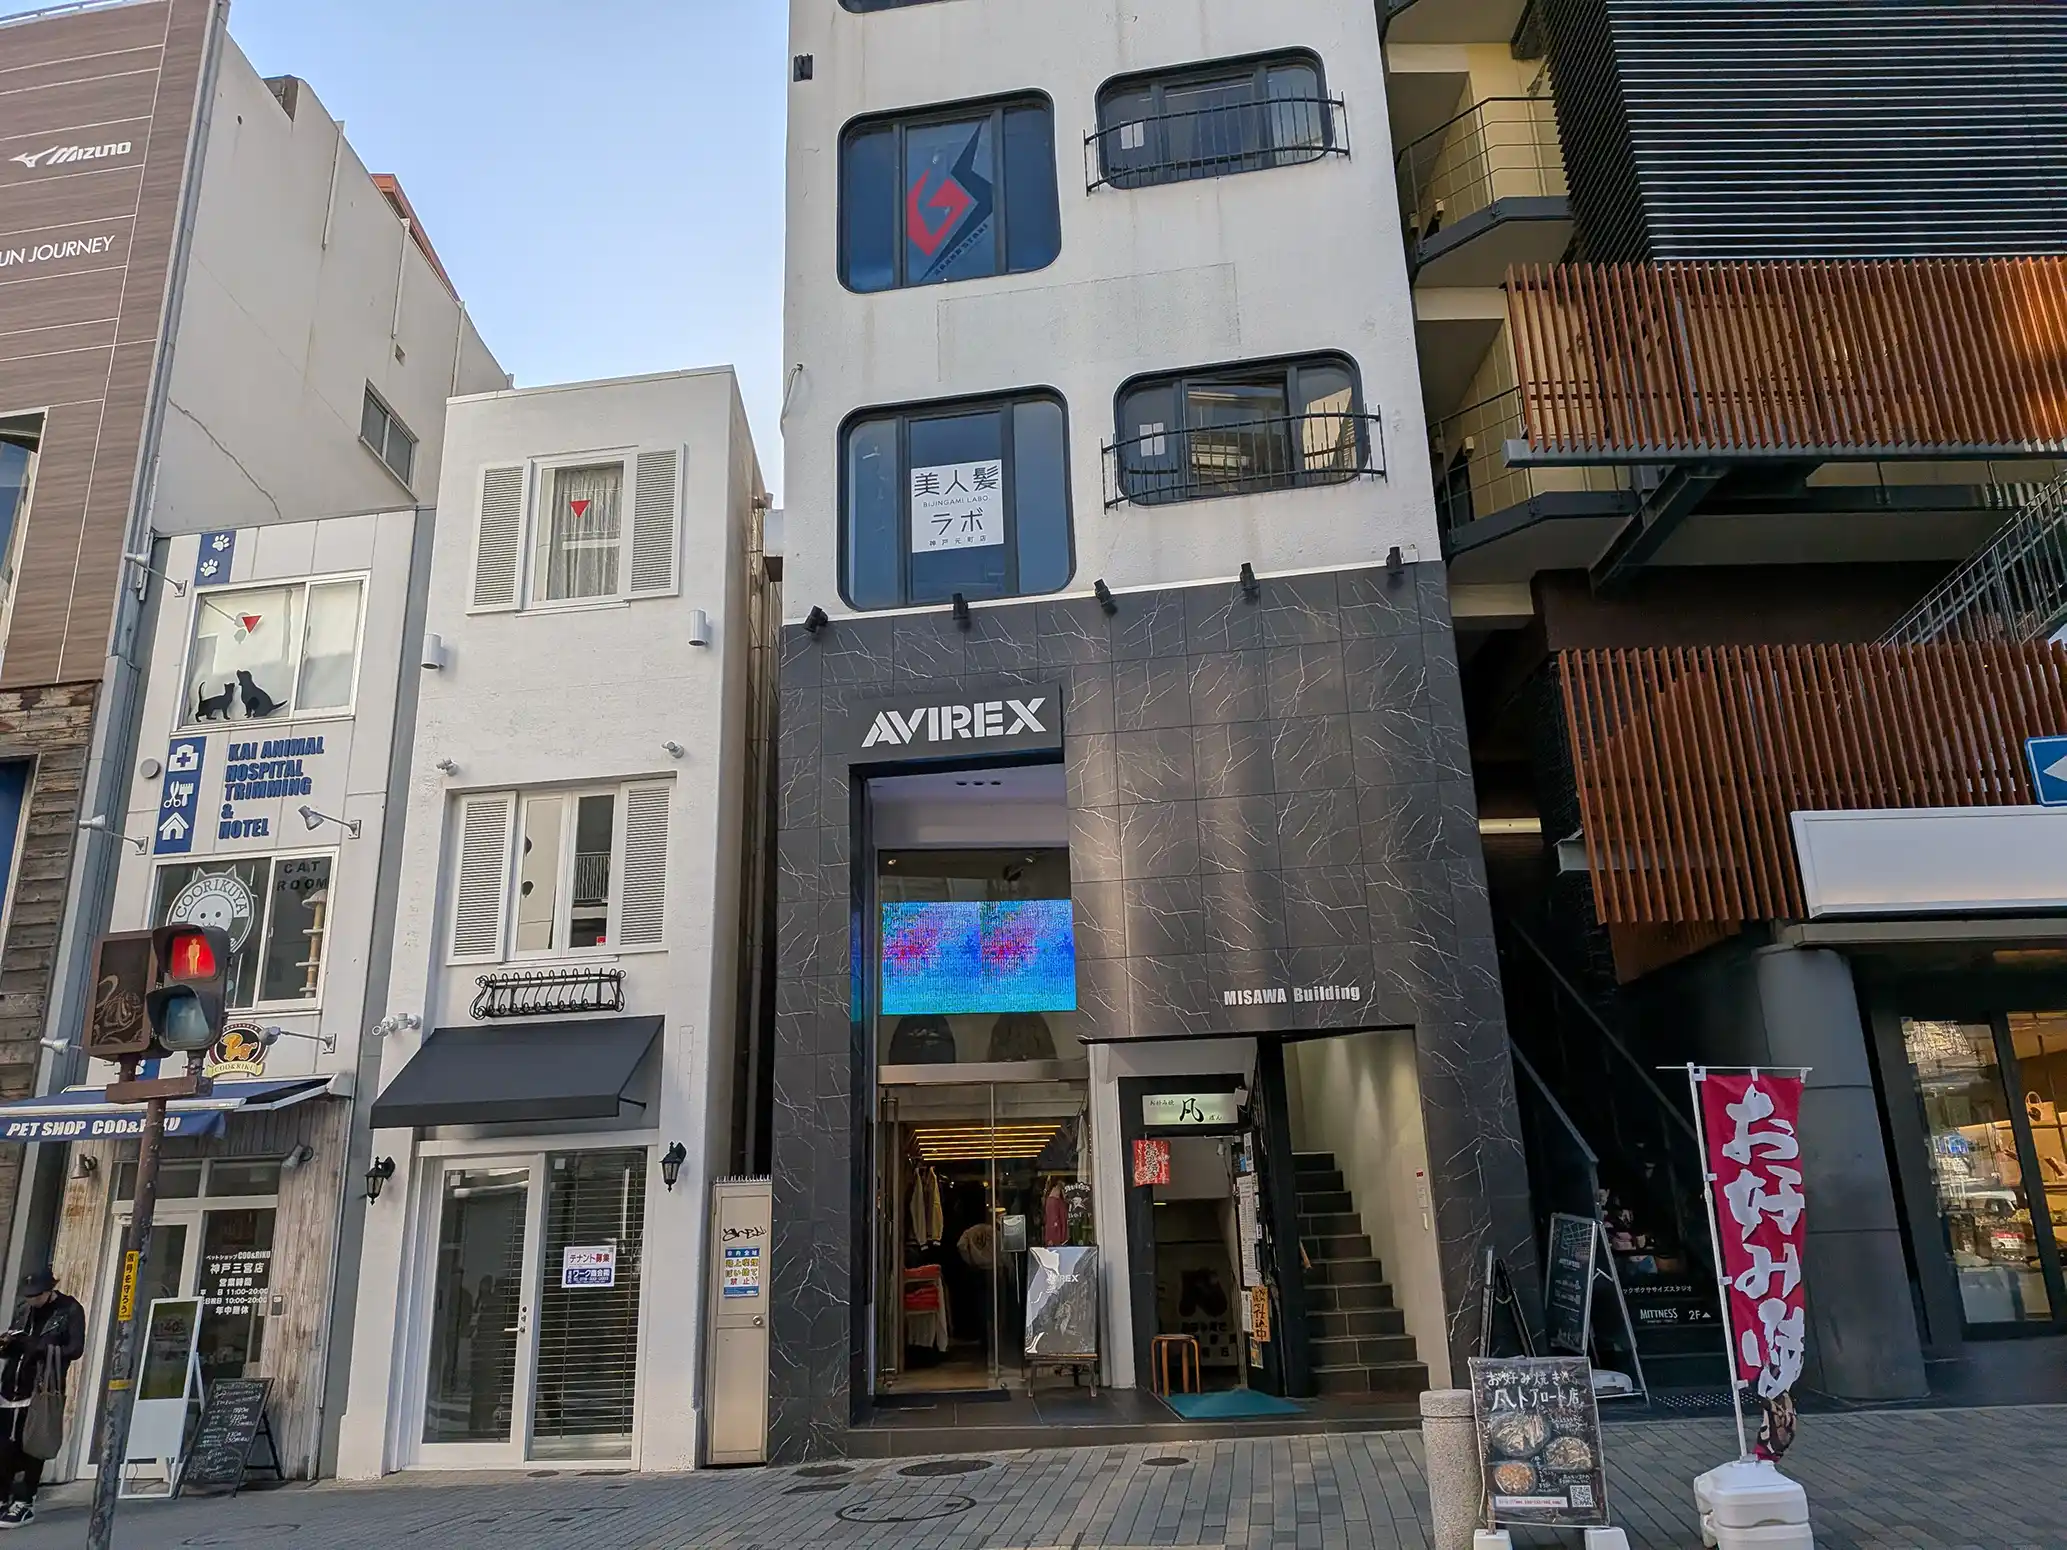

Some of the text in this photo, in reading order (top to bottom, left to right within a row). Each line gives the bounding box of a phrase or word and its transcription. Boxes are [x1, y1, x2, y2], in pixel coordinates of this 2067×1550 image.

[28, 235, 115, 262] JOURNEY
[914, 465, 999, 497] 美人髪
[923, 498, 964, 507] BIJINGAMI
[931, 507, 983, 535] ラボ
[929, 536, 986, 546] 神戸元町店
[861, 698, 1047, 747] AVIREX
[228, 736, 325, 761] KAI ANIMAL
[224, 759, 304, 782] HOSPITAL
[224, 777, 313, 801] TRIMMING
[221, 803, 234, 819] &
[218, 818, 270, 839] HOTEL
[284, 861, 321, 874] CAT
[276, 877, 328, 891] ROOM
[1224, 985, 1360, 1006] MISAWA Building
[6, 1122, 41, 1137] PET
[41, 1120, 87, 1136] SHOP
[570, 1253, 610, 1263] テナント募集
[210, 1262, 264, 1275] 神戸三宮店
[215, 1305, 249, 1315] 年中無休
[1640, 1308, 1700, 1320] MITTNESS 2F
